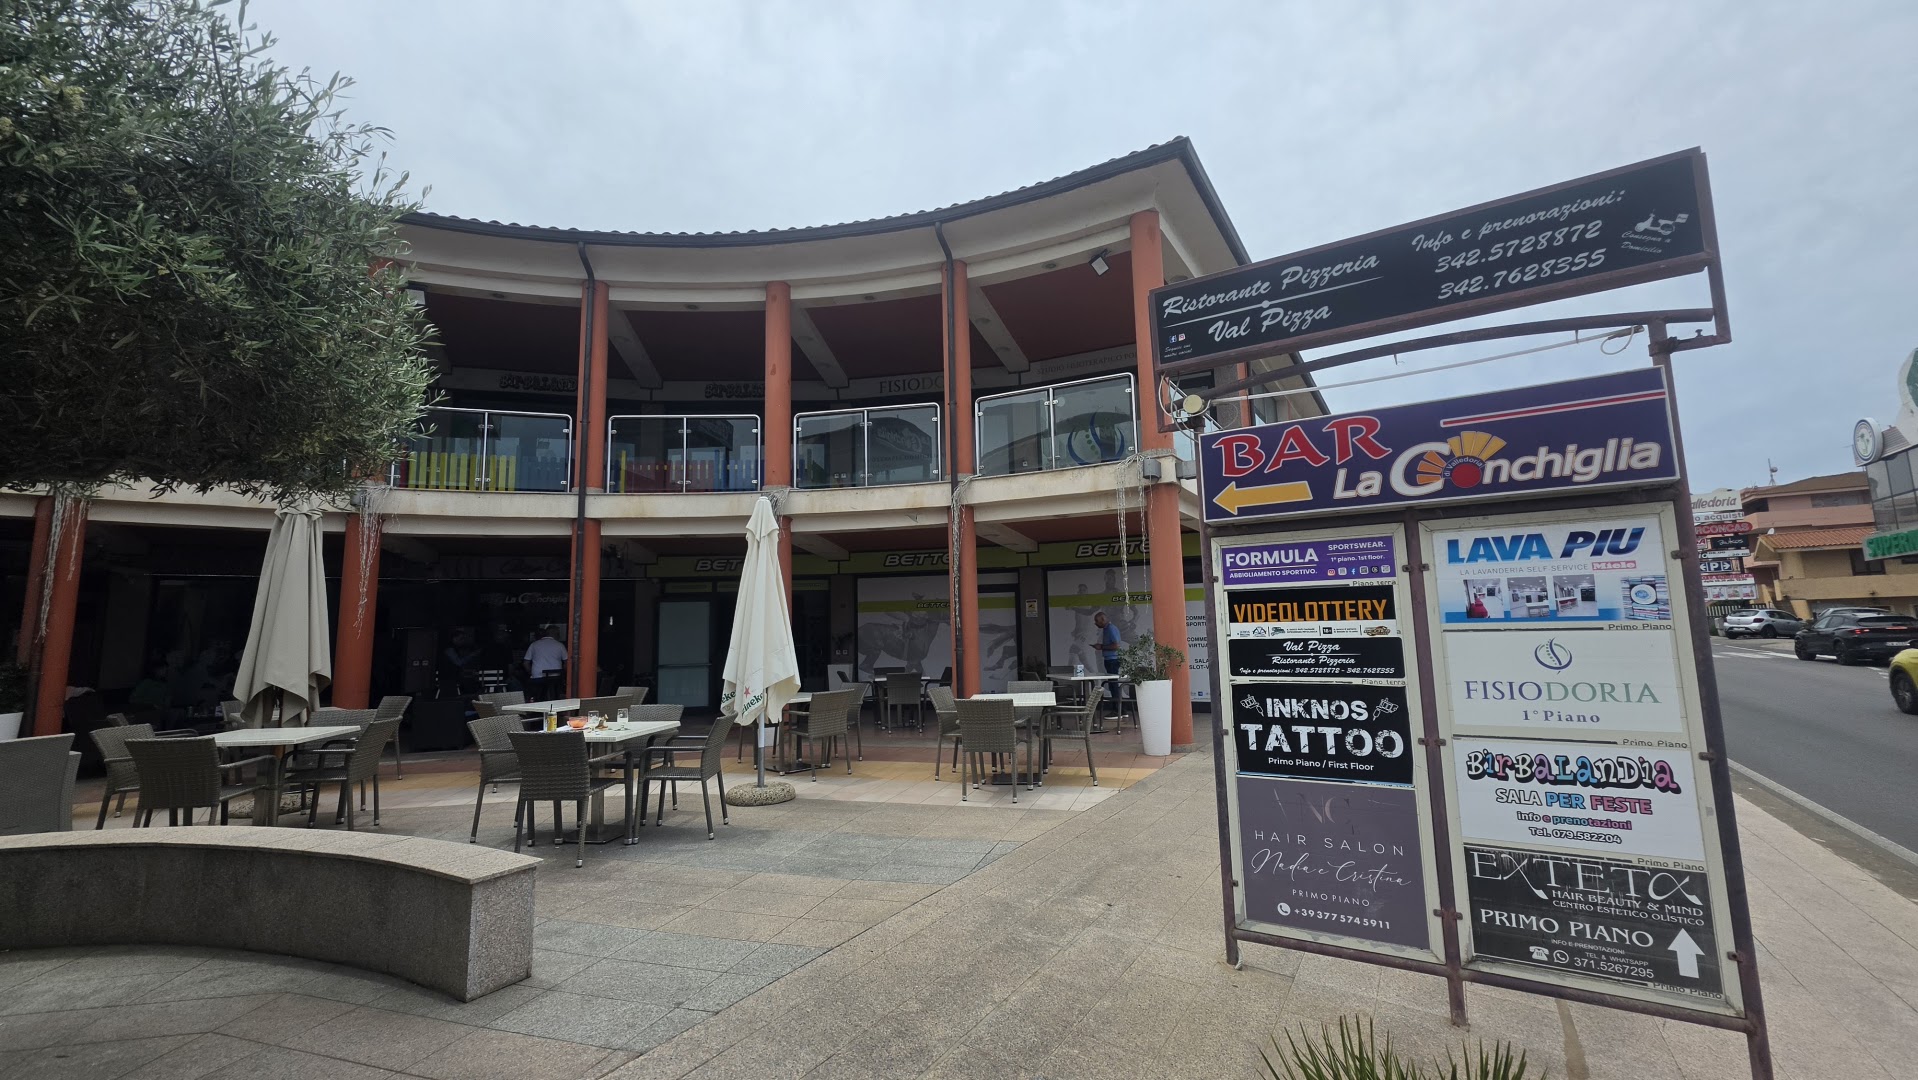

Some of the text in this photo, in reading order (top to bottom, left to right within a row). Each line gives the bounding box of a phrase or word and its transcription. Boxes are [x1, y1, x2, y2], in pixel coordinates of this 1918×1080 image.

[1411, 233, 1454, 252] Info
[1460, 228, 1473, 240] e
[1435, 220, 1603, 273] 342.5728872
[1437, 248, 1607, 300] 342.7628355
[1163, 254, 1380, 318] Ristorante Pizzeria
[1208, 305, 1332, 341] Val Pizza
[1212, 415, 1393, 478] BAR
[1446, 457, 1483, 470] Valledoria
[1332, 467, 1382, 500] La
[1691, 496, 1737, 509] alledoria
[1075, 539, 1150, 558] BETTE
[1328, 541, 1386, 551] SPORTSWEAR.
[1447, 527, 1645, 565] LAVA PIU
[696, 559, 743, 572] BET
[883, 552, 950, 567] BETTE
[1225, 548, 1319, 567] FORMULA
[1229, 570, 1281, 579] ABBIGLIAMENTO
[1472, 566, 1524, 575] LAVANDERIA
[1233, 599, 1387, 623] VIDEOLOTTERY
[1608, 623, 1672, 631] Primo Piano
[1283, 640, 1341, 654] Val Pizza
[1271, 656, 1356, 666] Ristorante Pizzeria
[1463, 680, 1662, 704] FISIODORIA
[1266, 697, 1369, 721] INKNOS
[1543, 710, 1601, 723] Piano
[1240, 723, 1404, 759] TATTOO
[1623, 739, 1688, 749] Primo Piano
[1268, 757, 1374, 771] Primo Piano / First Floor
[1495, 788, 1653, 815] SALA PER FESTE
[1517, 811, 1632, 831] info e prenotazioni
[1254, 830, 1404, 857] HAIR SALON
[1529, 827, 1622, 844] Tel. 079.582204
[1637, 857, 1705, 872] Primo Piano
[1327, 860, 1412, 893] Cristina
[1292, 888, 1370, 907] PRIMO PIANO
[1552, 890, 1704, 917] HAIR BEAUTY & MIND
[1552, 900, 1705, 927] CENTRO ESTETICO OLISTICO
[1480, 908, 1654, 948] PRIMO PIANO
[1574, 957, 1655, 979] 371.5267295
[1609, 956, 1649, 967] WHATSAPP
